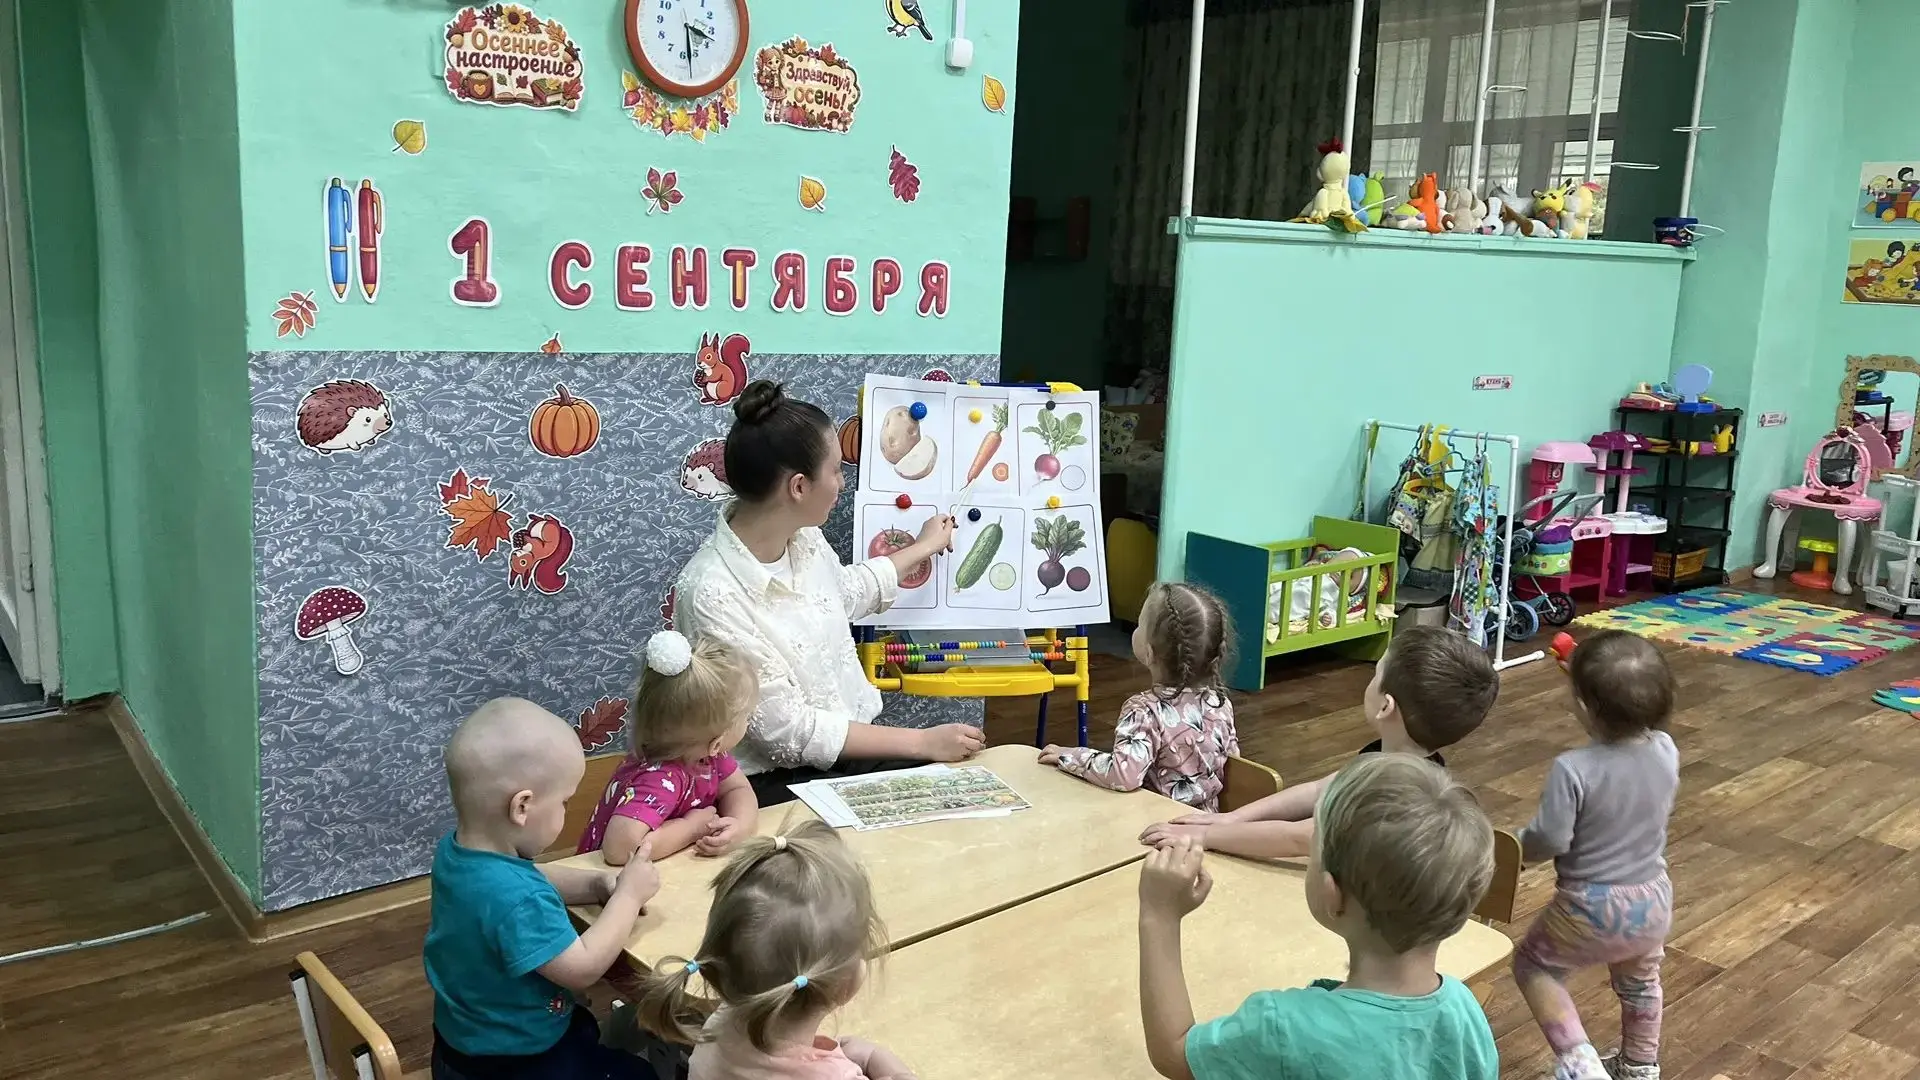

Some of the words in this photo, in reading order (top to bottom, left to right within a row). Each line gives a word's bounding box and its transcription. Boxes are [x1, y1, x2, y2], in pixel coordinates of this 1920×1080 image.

[659, 0, 672, 10] 10
[656, 15, 664, 24] 9
[706, 11, 713, 20] 2
[707, 26, 715, 35] 3
[658, 31, 665, 40] 8
[471, 28, 560, 58] Осеннее
[667, 43, 674, 52] 7
[703, 41, 710, 49] 4
[679, 51, 686, 60] 6
[692, 49, 699, 58] 5
[456, 50, 575, 78] настроение
[786, 61, 852, 95] Здравствуй,
[451, 218, 498, 303] 1
[550, 241, 948, 316] СЕНТЯБРЯ
